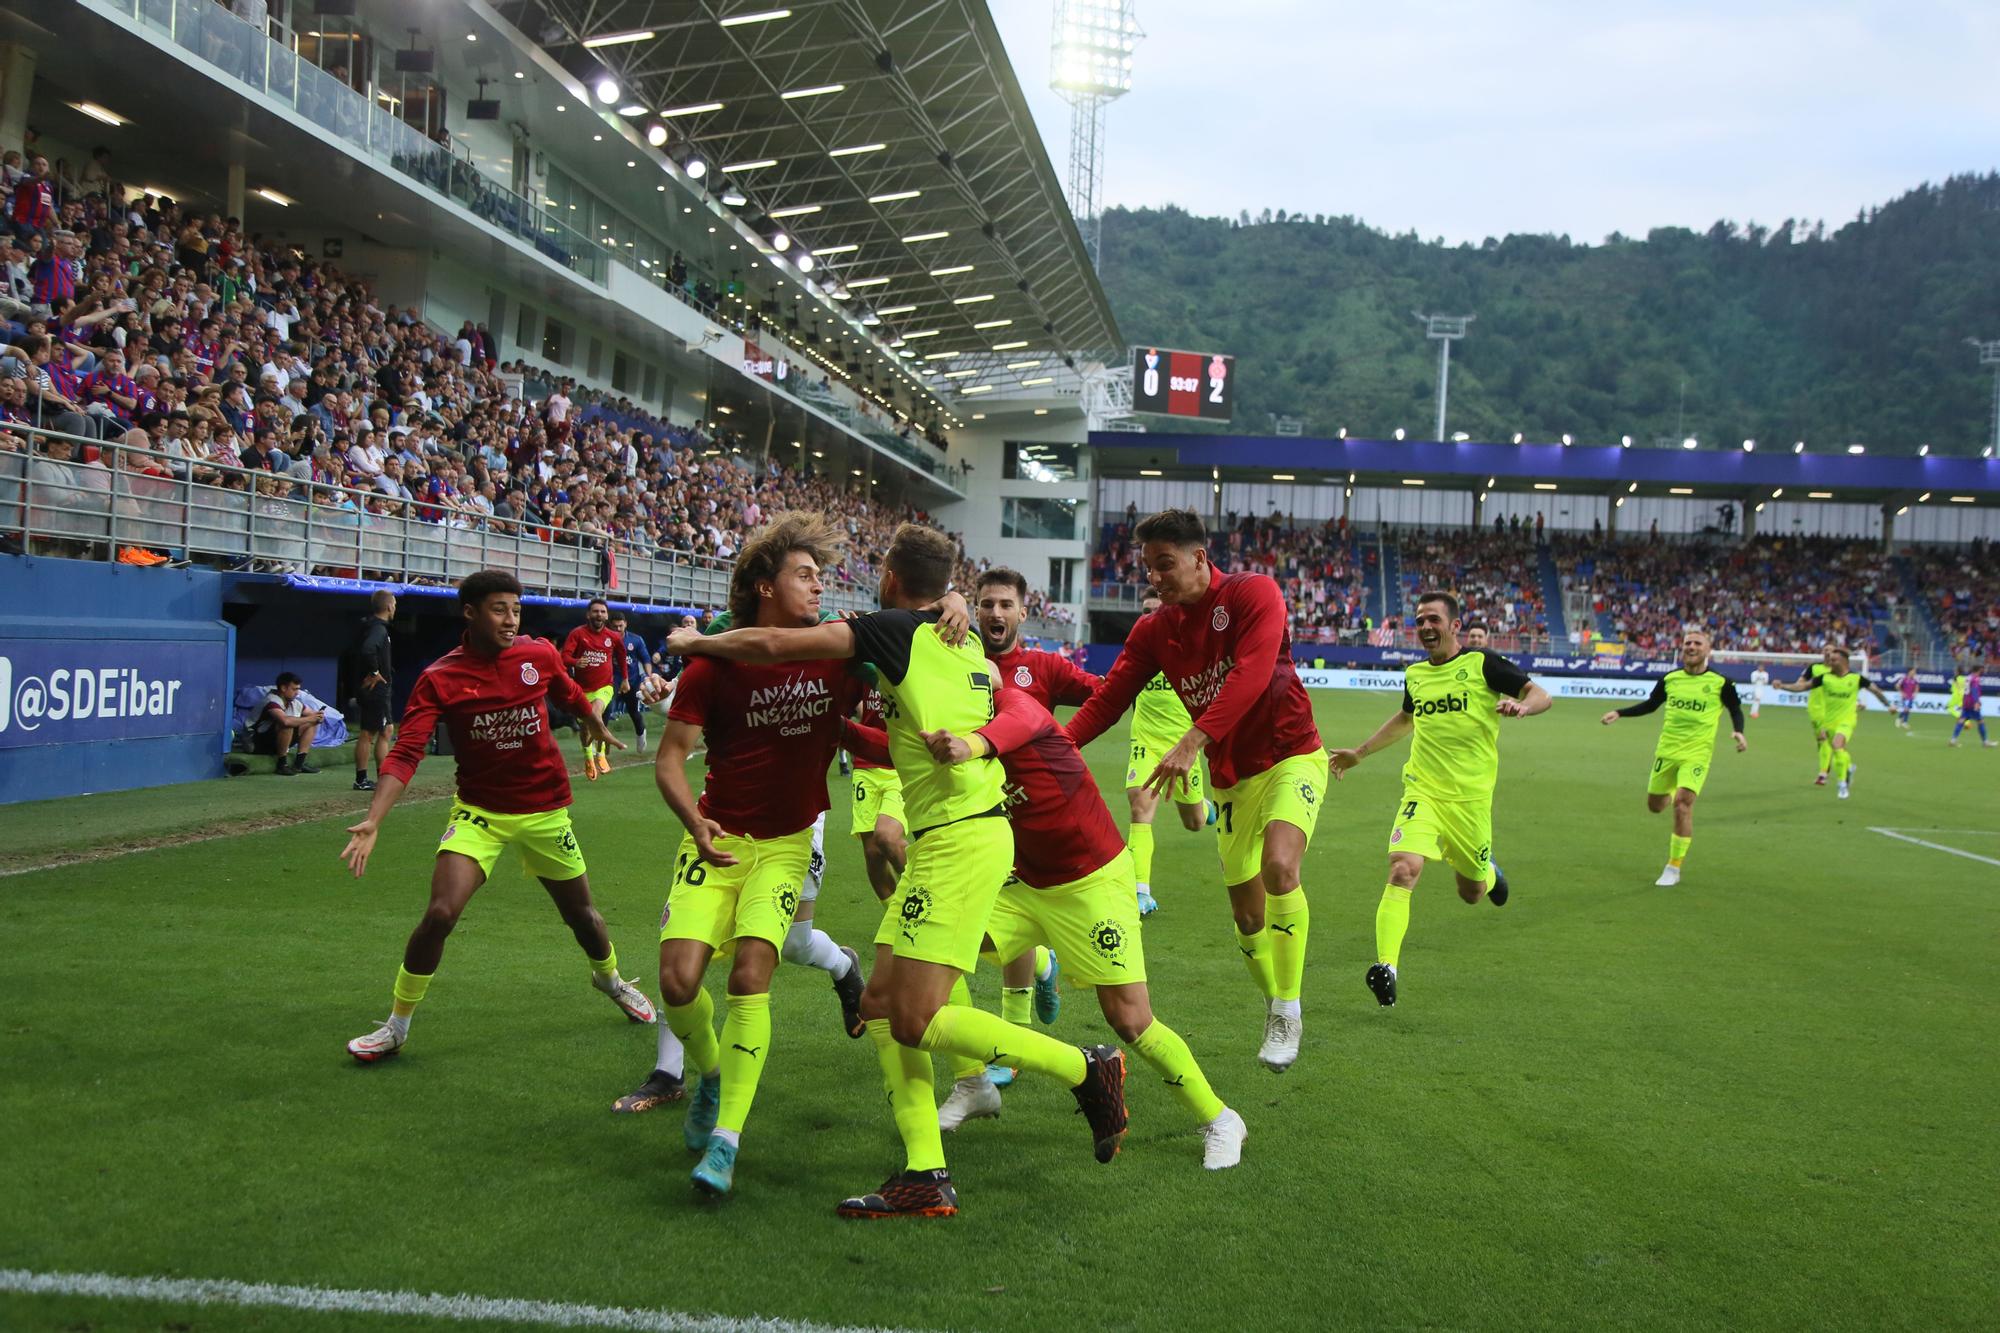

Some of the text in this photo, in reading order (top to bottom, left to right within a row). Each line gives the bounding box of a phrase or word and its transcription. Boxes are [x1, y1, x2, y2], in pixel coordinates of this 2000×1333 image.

[1143, 368, 1159, 397] 0
[1209, 378, 1224, 403] 2
[1145, 677, 1173, 691] osb
[15, 669, 182, 731] @SDEibar
[1669, 696, 1707, 712] Gosbi
[780, 722, 811, 736] Gosbi
[495, 740, 523, 750] Gosbi
[1402, 801, 1418, 820] 4
[1089, 918, 1126, 938] Costa Brava
[1102, 933, 1117, 945] G!
